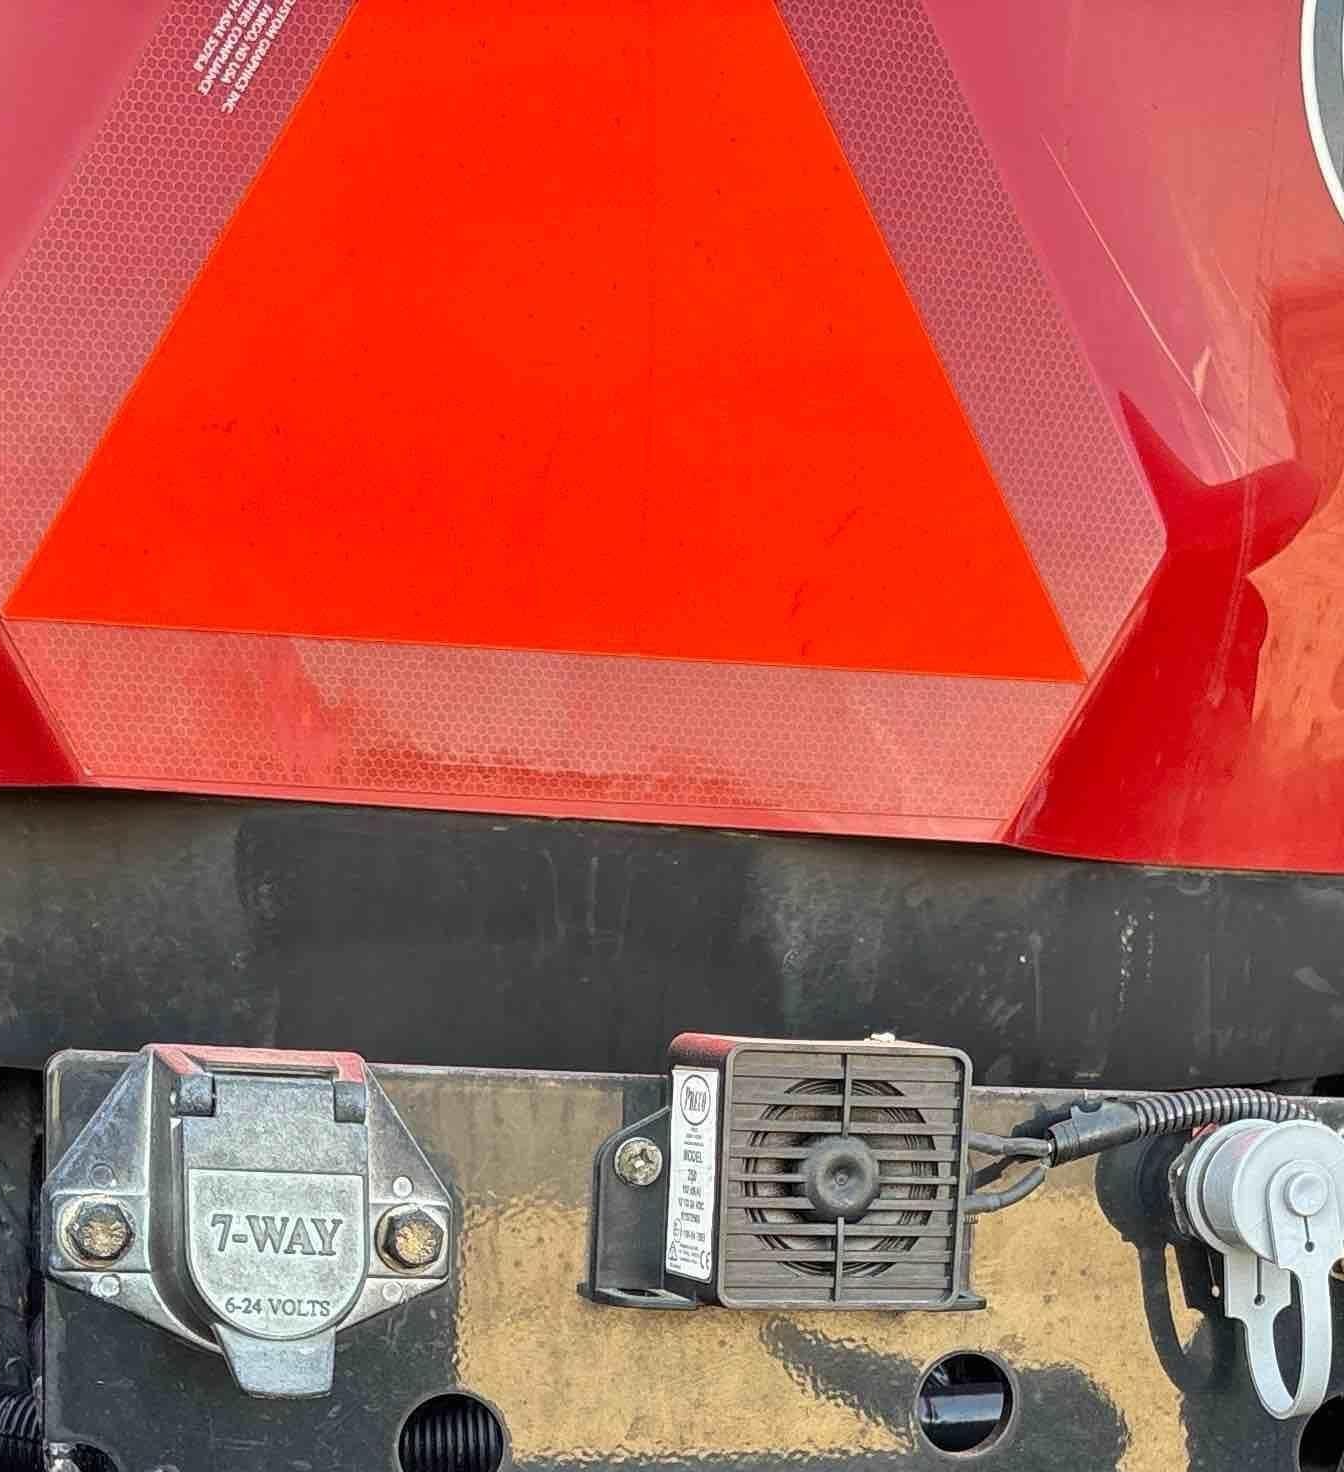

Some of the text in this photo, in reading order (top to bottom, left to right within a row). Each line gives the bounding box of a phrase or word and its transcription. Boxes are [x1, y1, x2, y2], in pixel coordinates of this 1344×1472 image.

[265, 0, 297, 39] USTOM
[196, 25, 244, 95] COMPLIANCE
[220, 61, 239, 84] USA
[234, 37, 272, 92] GRAPHICS
[211, 1213, 343, 1257] 7-WAY
[225, 1297, 331, 1317] 6-24 VOLTS
